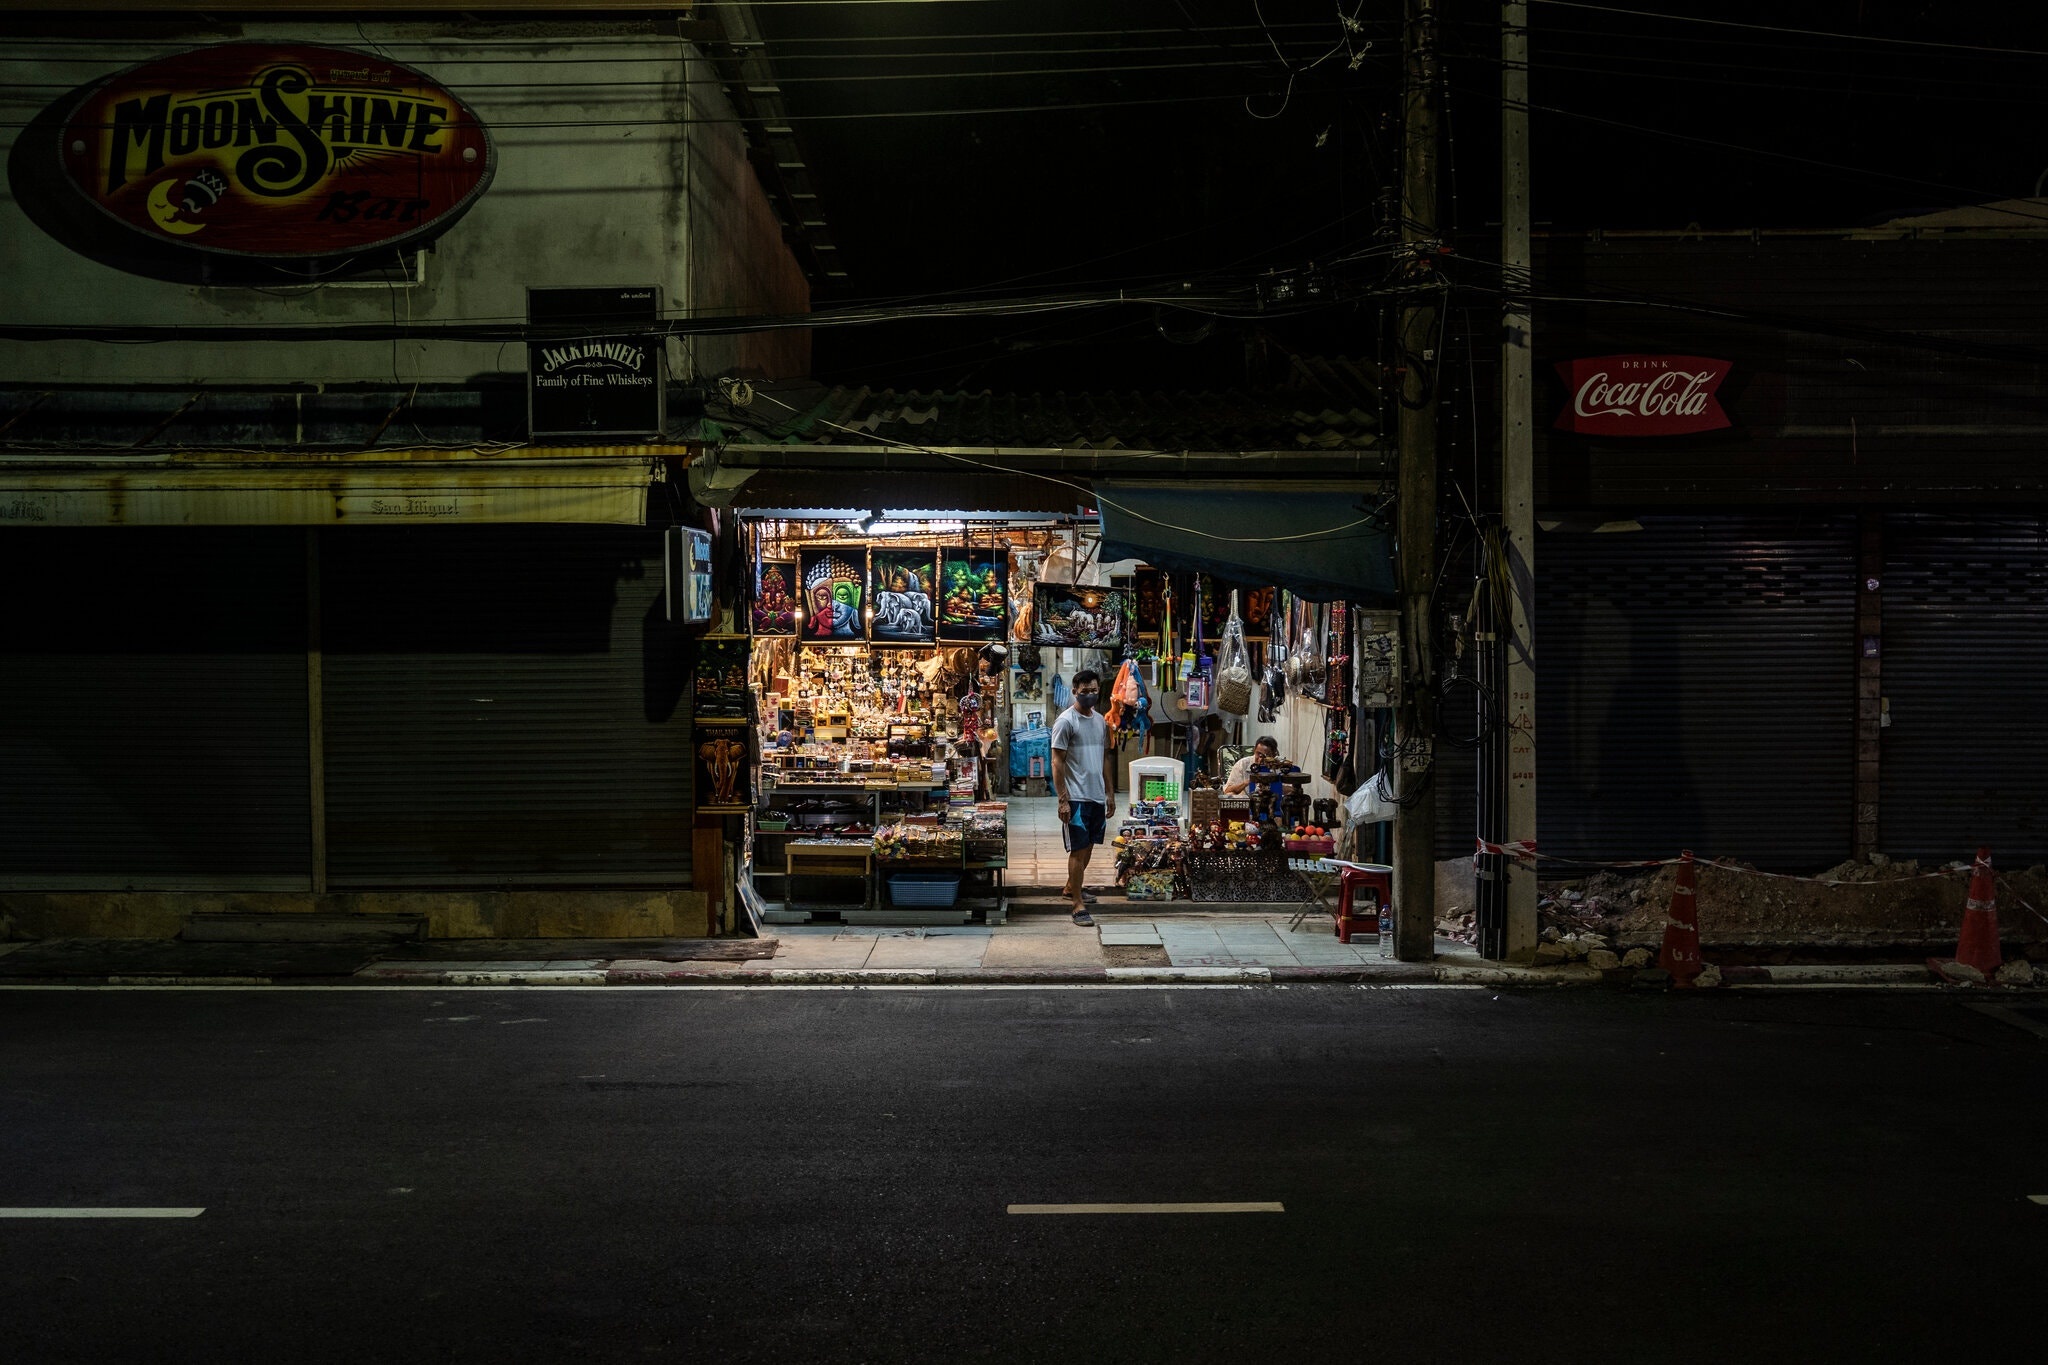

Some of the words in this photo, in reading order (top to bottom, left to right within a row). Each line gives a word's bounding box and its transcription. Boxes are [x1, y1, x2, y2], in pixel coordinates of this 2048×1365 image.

[316, 190, 430, 223] Bar
[541, 345, 583, 373] JACK
[1622, 360, 1669, 369] DRINK
[536, 374, 568, 389] Family
[571, 374, 581, 387] of
[583, 374, 604, 386] Fine
[606, 373, 653, 388] Whiskeys
[1574, 371, 1717, 417] Coca-Cola
[371, 499, 402, 516] San
[405, 497, 459, 518] Miguel
[705, 728, 738, 737] THAILAND
